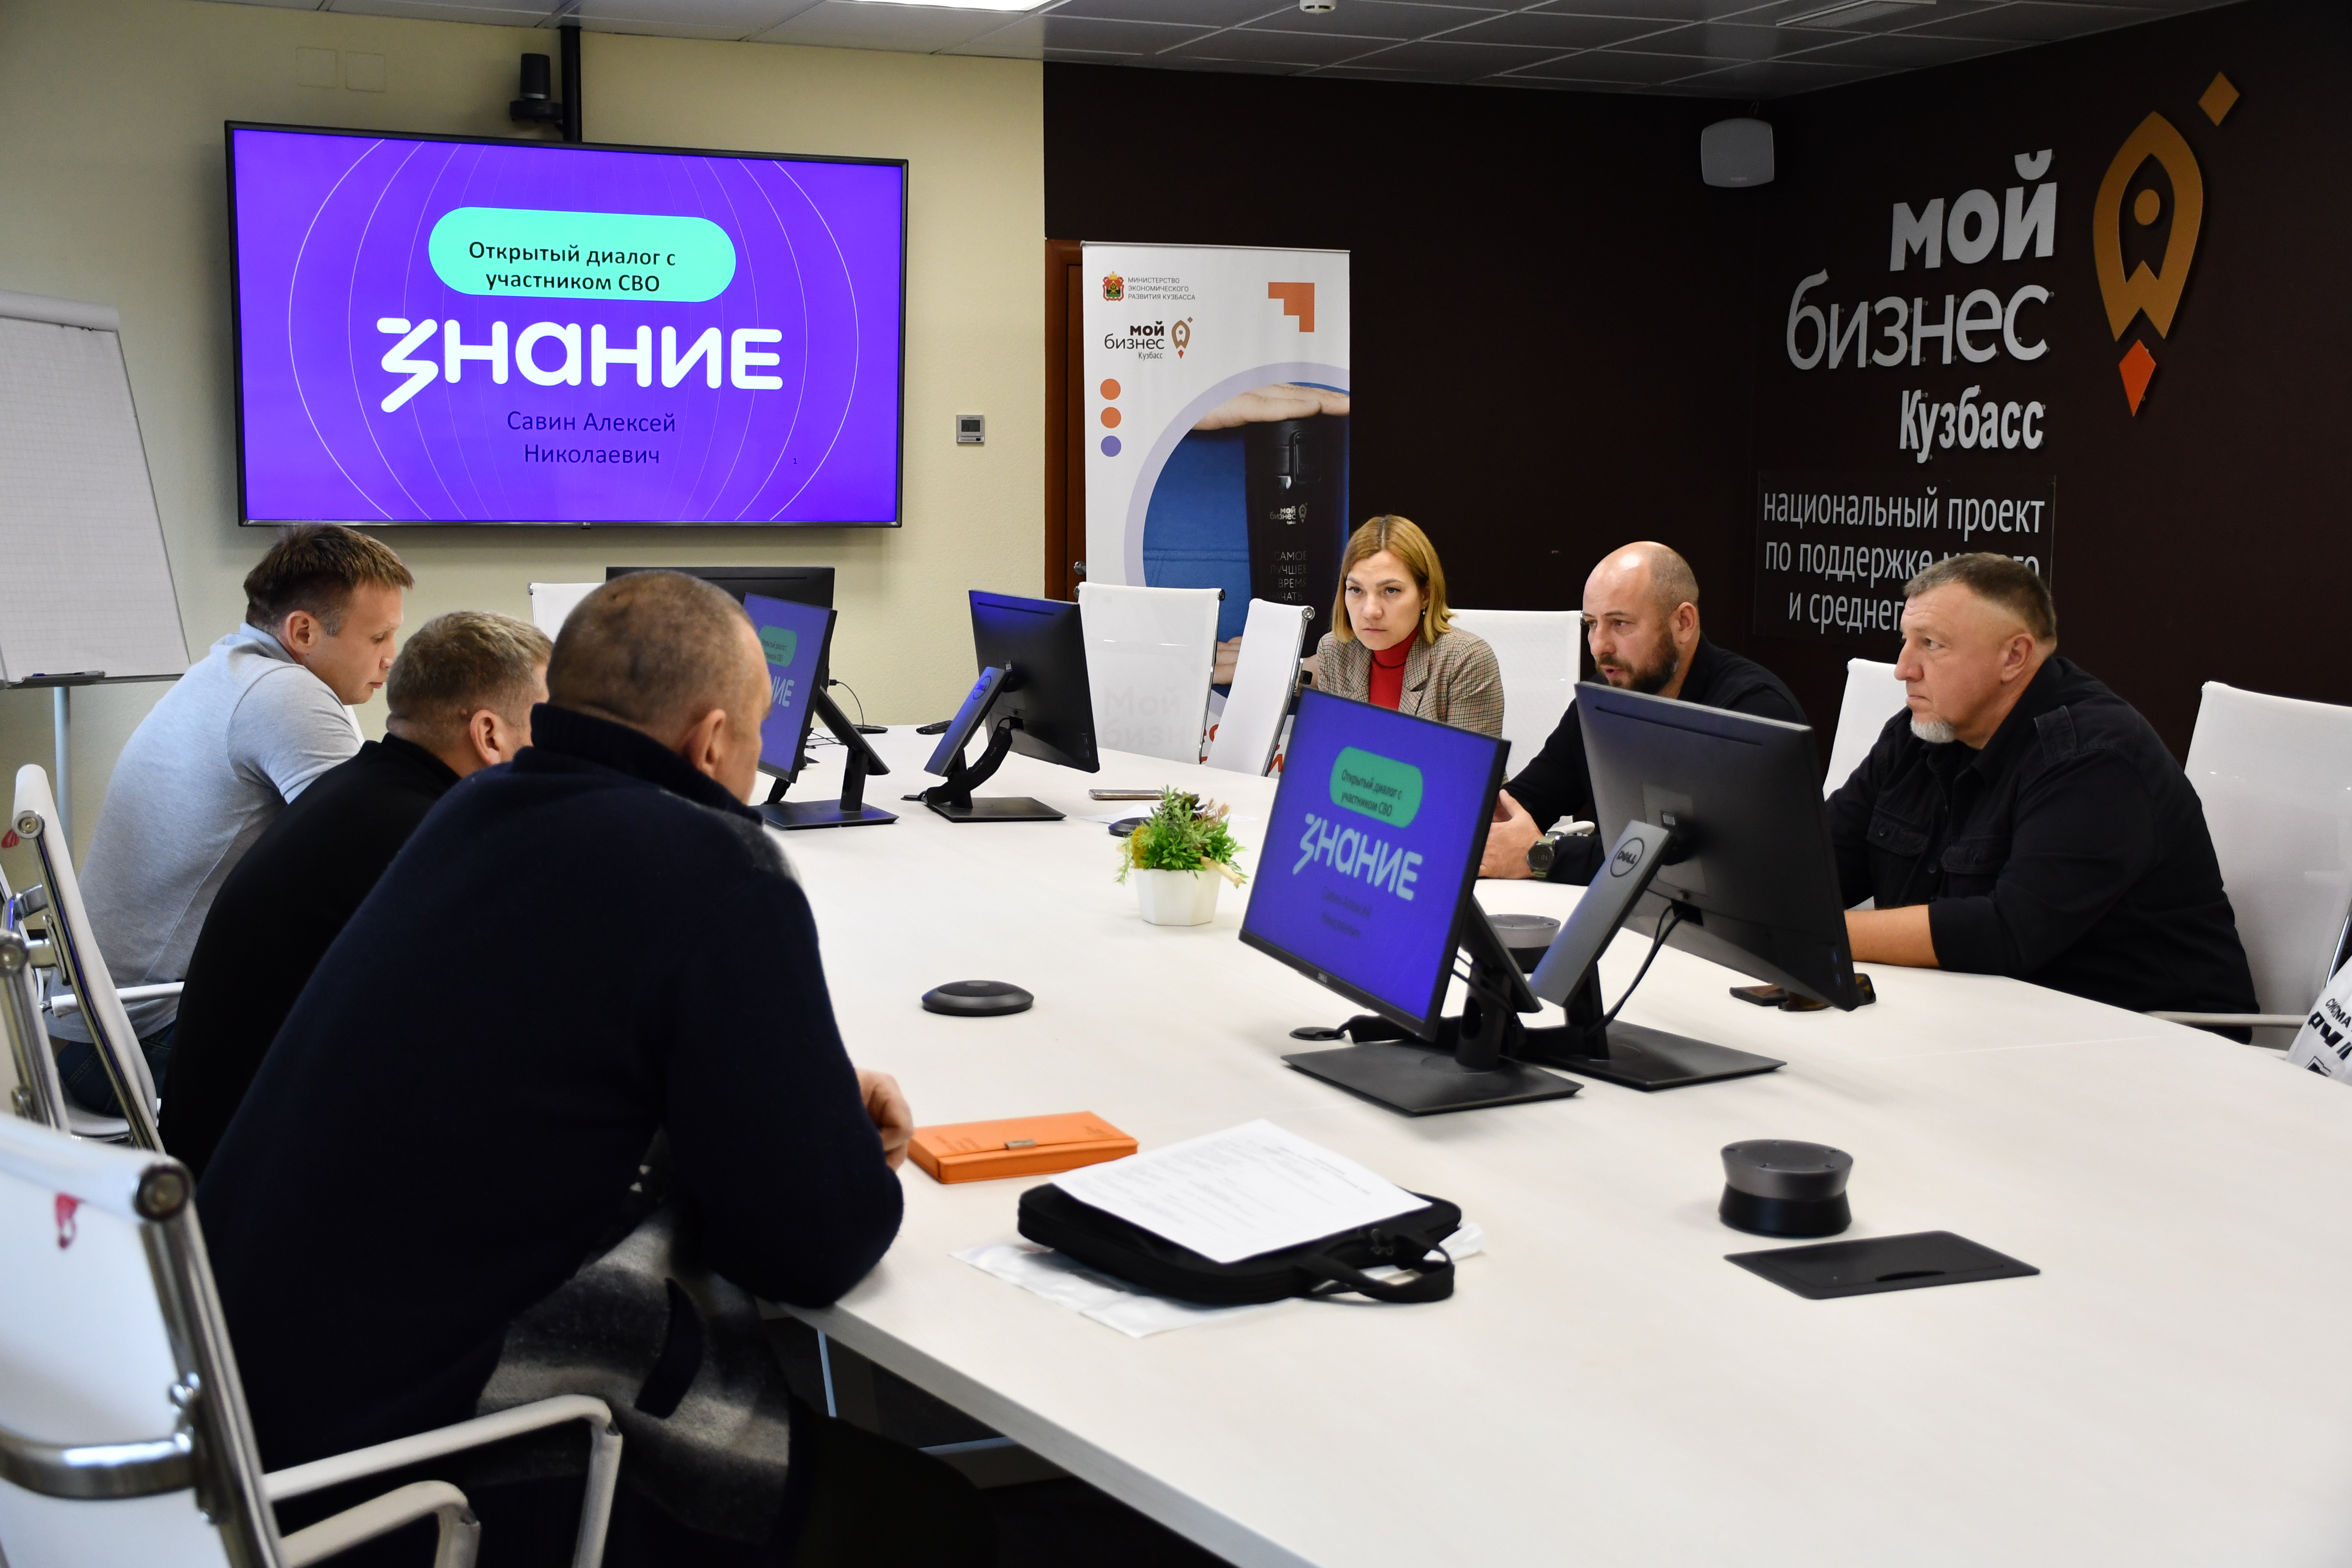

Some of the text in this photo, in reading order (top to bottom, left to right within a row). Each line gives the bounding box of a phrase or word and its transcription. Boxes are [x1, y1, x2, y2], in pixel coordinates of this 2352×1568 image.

[468, 241, 677, 267] Открытый диалог с
[485, 272, 660, 292] участником СВО
[1130, 321, 1164, 336] мой
[1786, 268, 2050, 370] бизнес
[1105, 333, 1165, 349] бизнес
[1138, 351, 1163, 361] Кузбасс
[507, 411, 676, 433] Савин Алексей
[1899, 385, 2044, 464] Кузбасс
[524, 444, 660, 464] Николаевич
[1270, 511, 1296, 520] бизнес
[1764, 486, 2045, 542] национальный проект
[1274, 551, 1307, 561] САМОЕ
[1765, 542, 1791, 572] по
[1789, 592, 1904, 634] и среднег
[1342, 769, 1375, 789] Открытый
[1373, 782, 1397, 797] диалог
[1341, 791, 1393, 817] участником СВО
[1617, 850, 1637, 865] DELL
